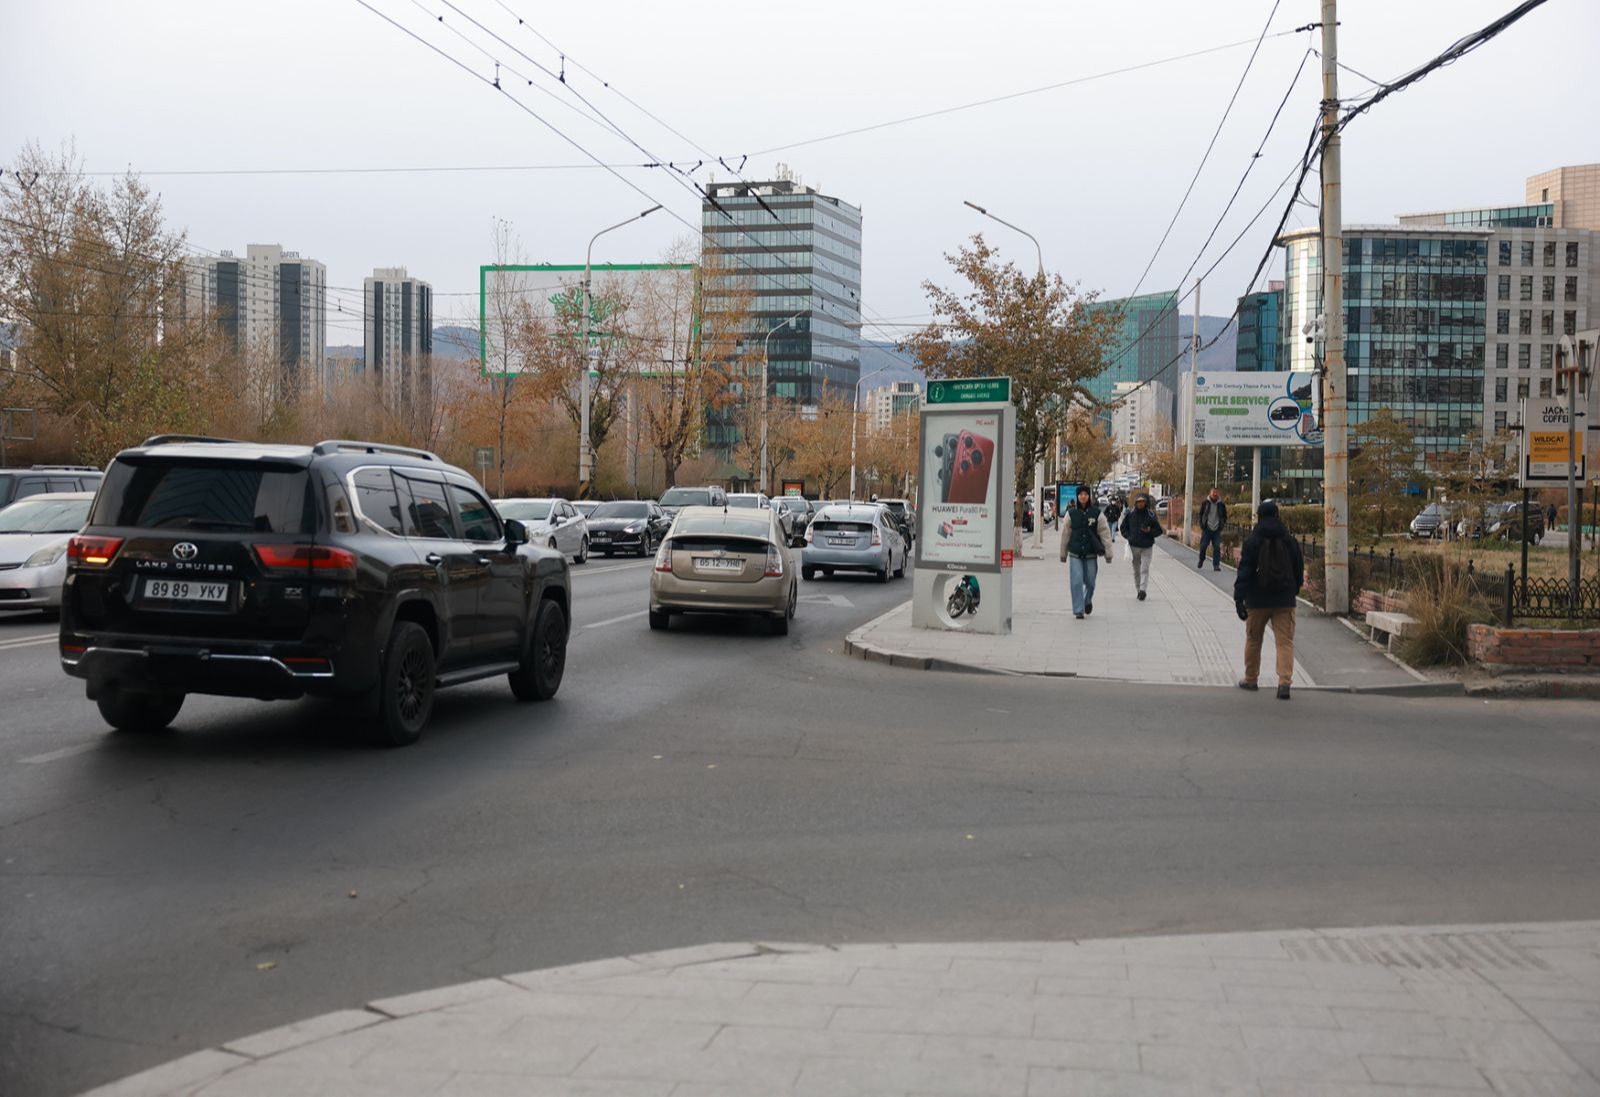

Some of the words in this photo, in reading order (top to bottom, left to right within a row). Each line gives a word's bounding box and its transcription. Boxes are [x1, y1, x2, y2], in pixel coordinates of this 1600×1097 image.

[1196, 396, 1228, 405] HUTTLE
[1230, 396, 1270, 405] SERVICE
[136, 561, 168, 569] LAND
[200, 584, 224, 599] УКУ
